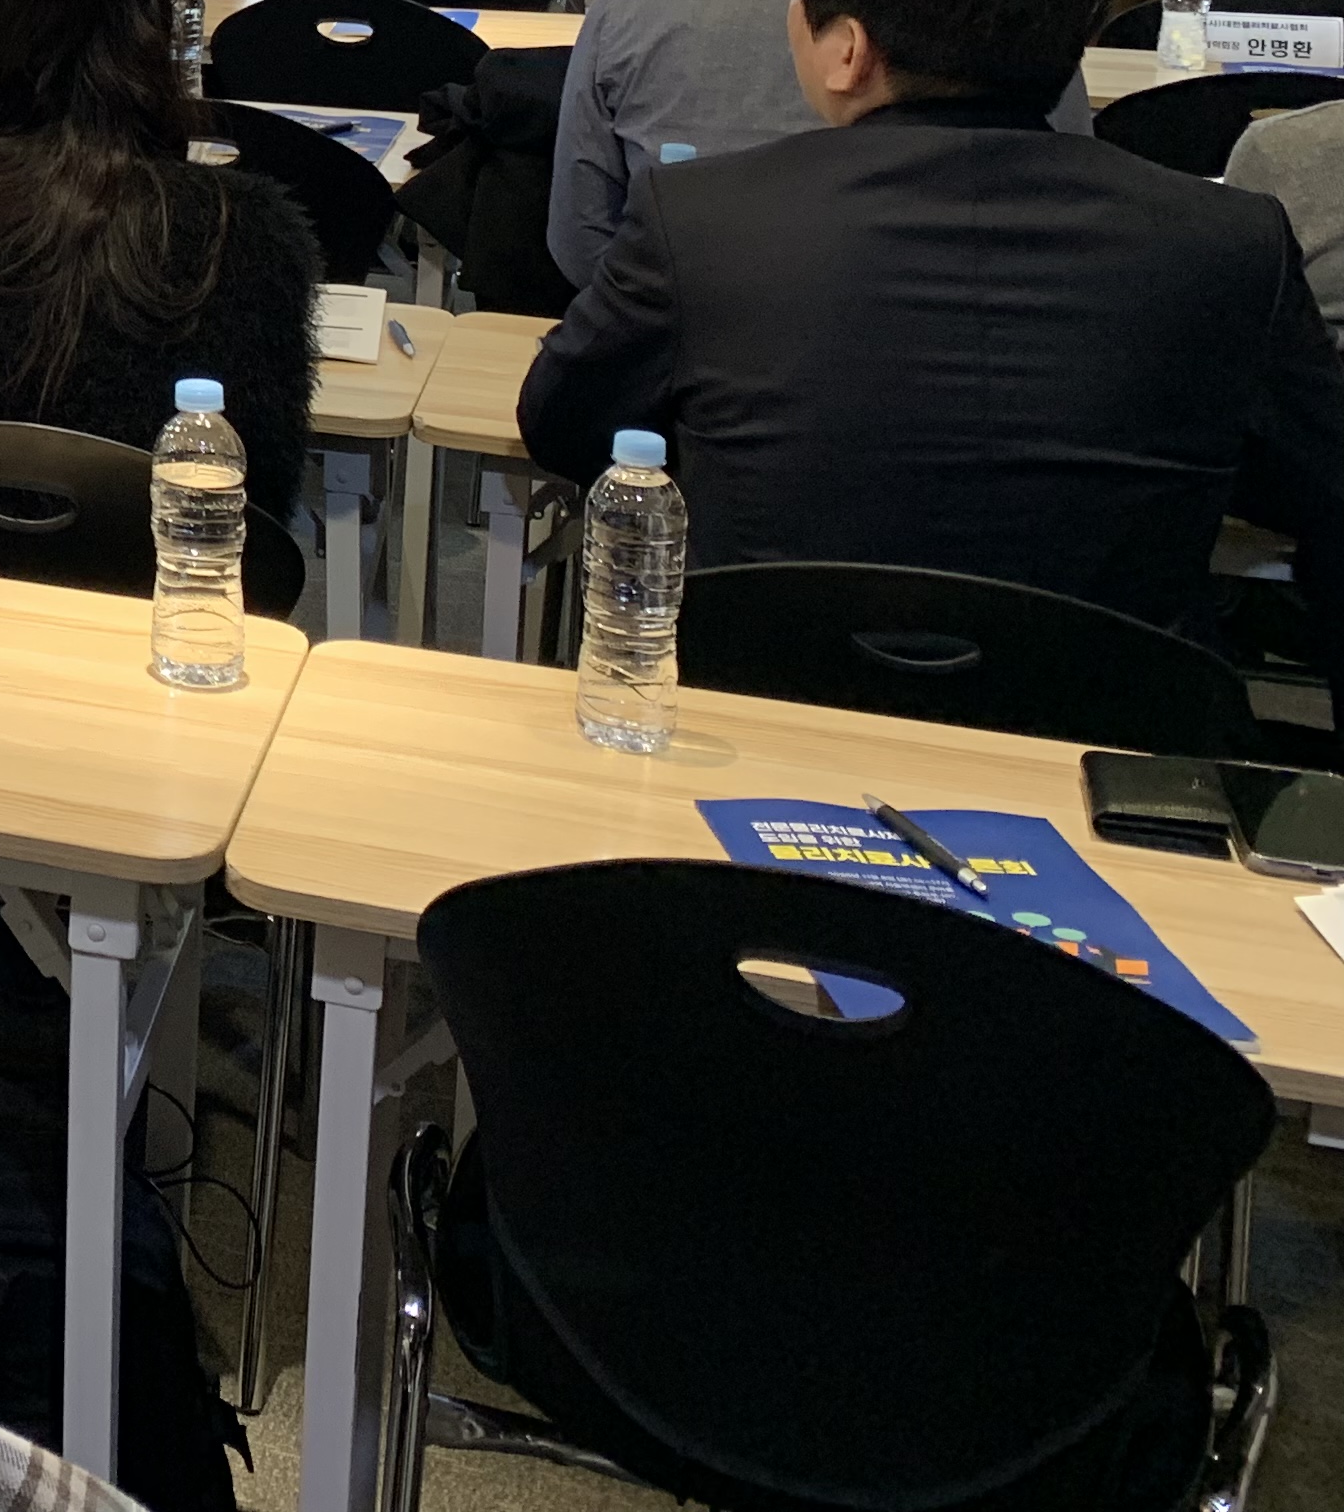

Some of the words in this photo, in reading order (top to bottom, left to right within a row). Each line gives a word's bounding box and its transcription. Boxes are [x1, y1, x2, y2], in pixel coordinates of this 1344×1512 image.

[1247, 38, 1313, 59] 안명환
[822, 834, 862, 848] 위한
[768, 843, 932, 870] 물리치료사
